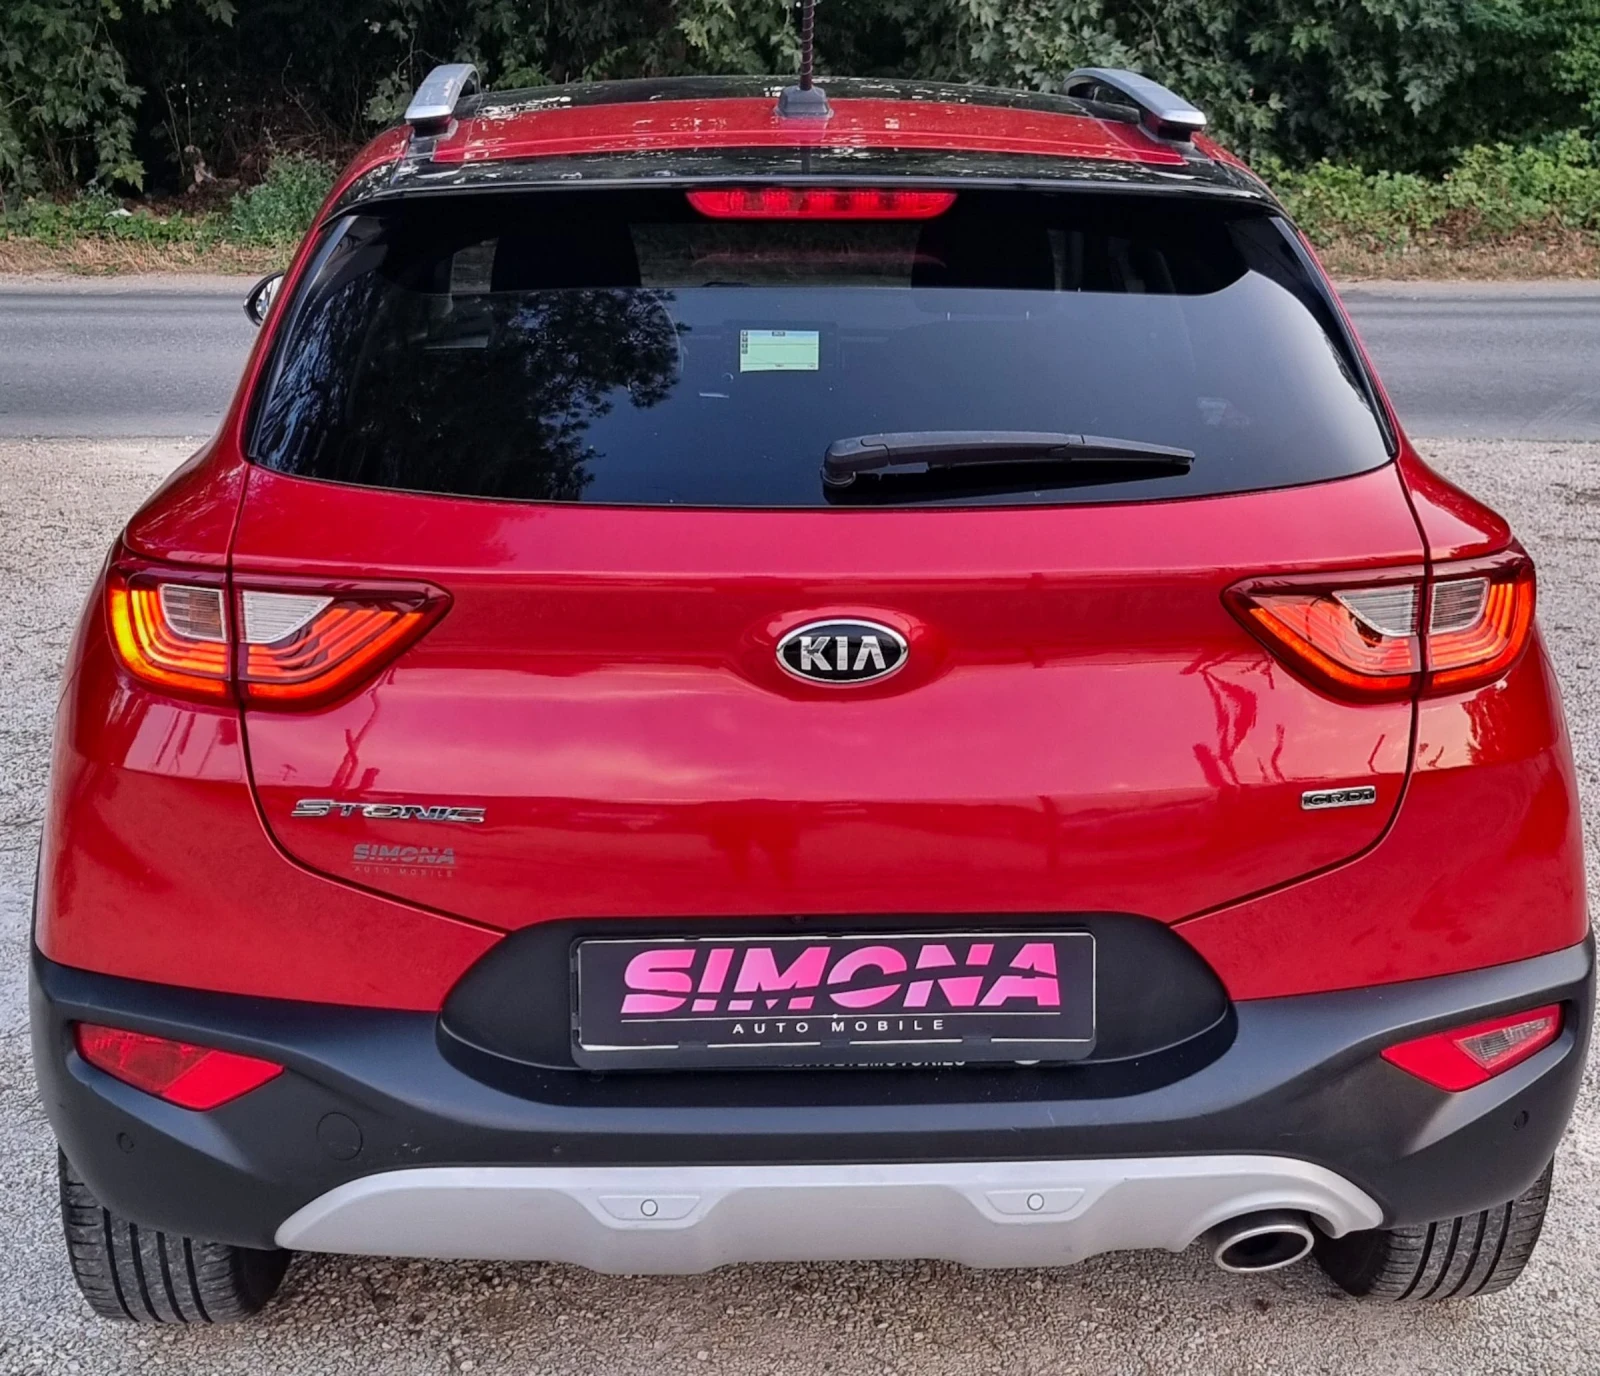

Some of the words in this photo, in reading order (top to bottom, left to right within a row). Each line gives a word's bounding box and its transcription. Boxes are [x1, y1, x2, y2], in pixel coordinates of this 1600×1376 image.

[798, 635, 887, 671] KIA
[291, 799, 487, 822] STONIC
[353, 844, 455, 864] SIMONA
[354, 866, 390, 875] AUTO
[399, 867, 453, 877] MOBILE
[620, 943, 1061, 1013] SIMONA
[732, 1022, 808, 1035] AUTO
[831, 1019, 943, 1033] MOBILE
